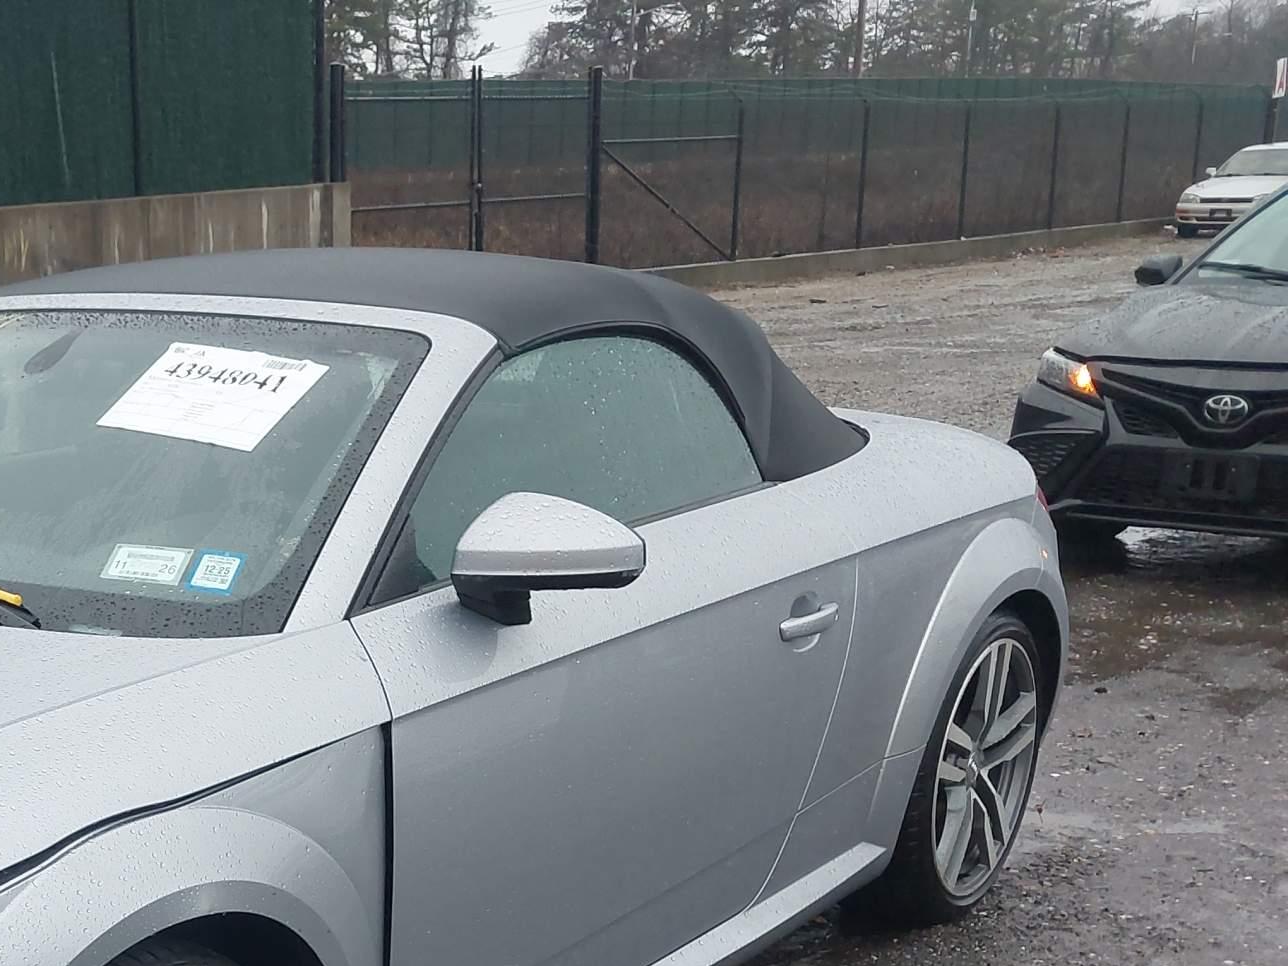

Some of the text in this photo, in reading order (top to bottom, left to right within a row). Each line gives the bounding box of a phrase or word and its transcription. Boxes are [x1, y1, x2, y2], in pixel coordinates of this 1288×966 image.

[164, 361, 288, 394] 43948041
[114, 559, 128, 570] 11
[158, 563, 177, 575] 26
[204, 564, 232, 576] 12-25
